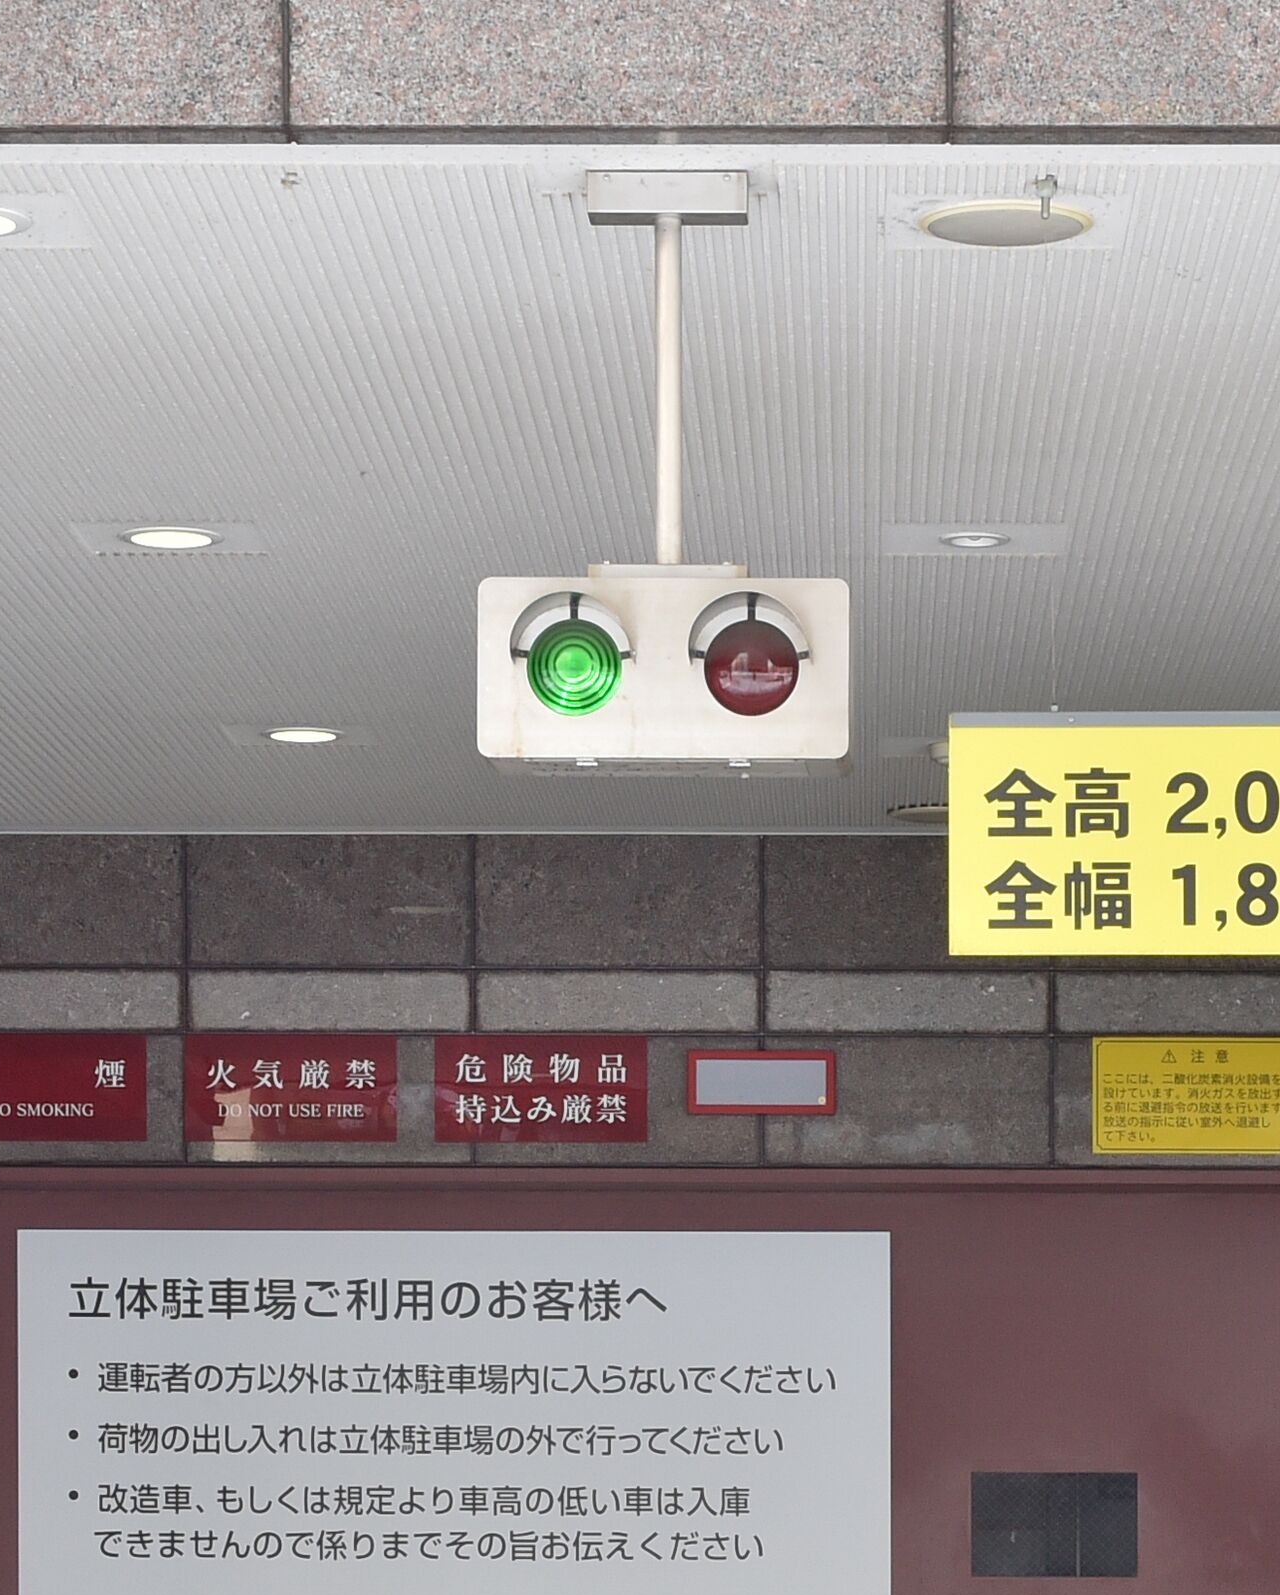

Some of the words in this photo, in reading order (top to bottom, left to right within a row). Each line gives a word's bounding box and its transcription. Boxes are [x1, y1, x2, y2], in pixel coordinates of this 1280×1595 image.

[984, 767, 1131, 839] 全高
[984, 860, 1131, 931] 全幅
[207, 1059, 378, 1090] 火気厳禁
[455, 1053, 629, 1085] 危険物品
[16, 1102, 95, 1118] SMOKING
[218, 1103, 245, 1119] DO
[248, 1103, 284, 1119] NOT
[289, 1103, 322, 1119] USE
[326, 1103, 365, 1119] FIRE
[455, 1093, 629, 1125] 持込み厳禁
[67, 1276, 669, 1322] 立体駐車場ご利用のお客様へ
[97, 1362, 838, 1396] 運転者の方以外は立体駐車場内に入らないでください
[97, 1423, 785, 1457] 荷物の出し入れは立体駐車場の外で行ってください
[97, 1484, 751, 1517] 改造車、もしくは規定より車高の低い車は入庫
[94, 1529, 764, 1562] できませんので係りまでその旨お伝えください
